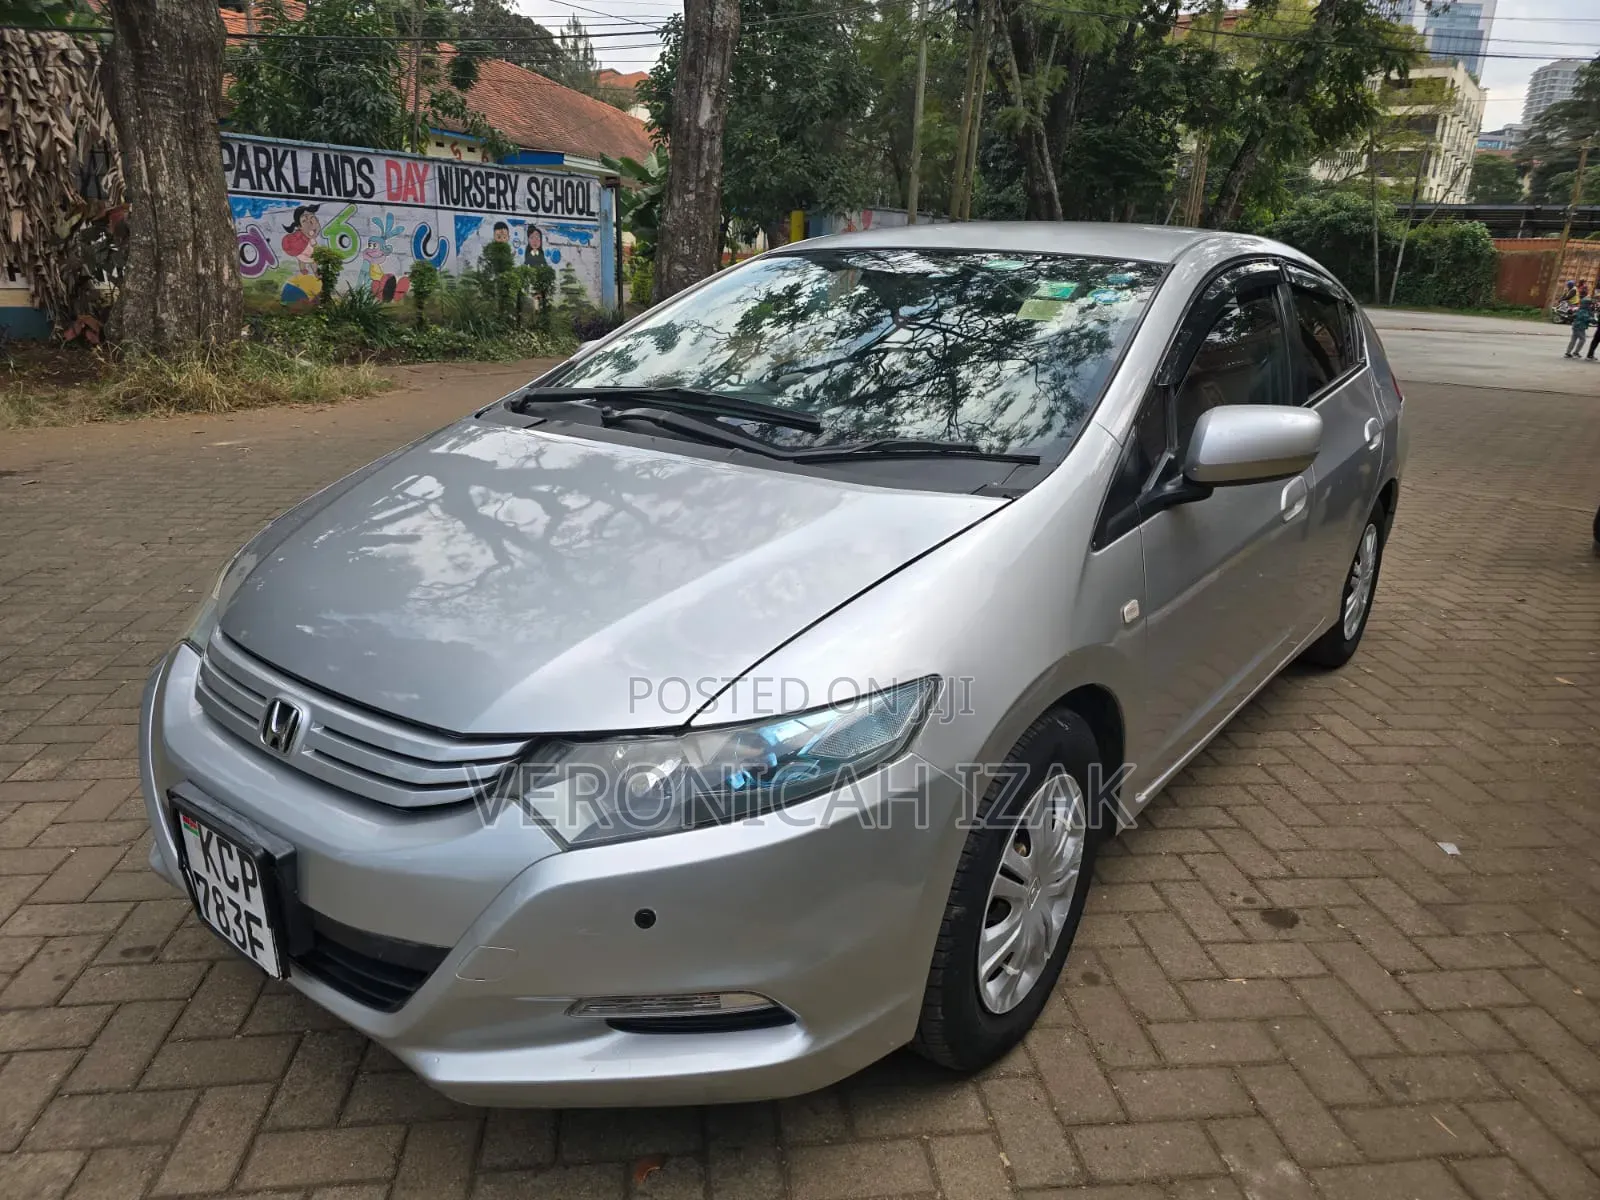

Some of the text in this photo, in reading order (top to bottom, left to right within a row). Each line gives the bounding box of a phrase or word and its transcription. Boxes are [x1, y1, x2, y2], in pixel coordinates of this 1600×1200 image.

[221, 142, 597, 216] PARKLANDS DAY NURSERY SCHOOL
[200, 830, 258, 903] KCP
[193, 870, 266, 960] 783F
